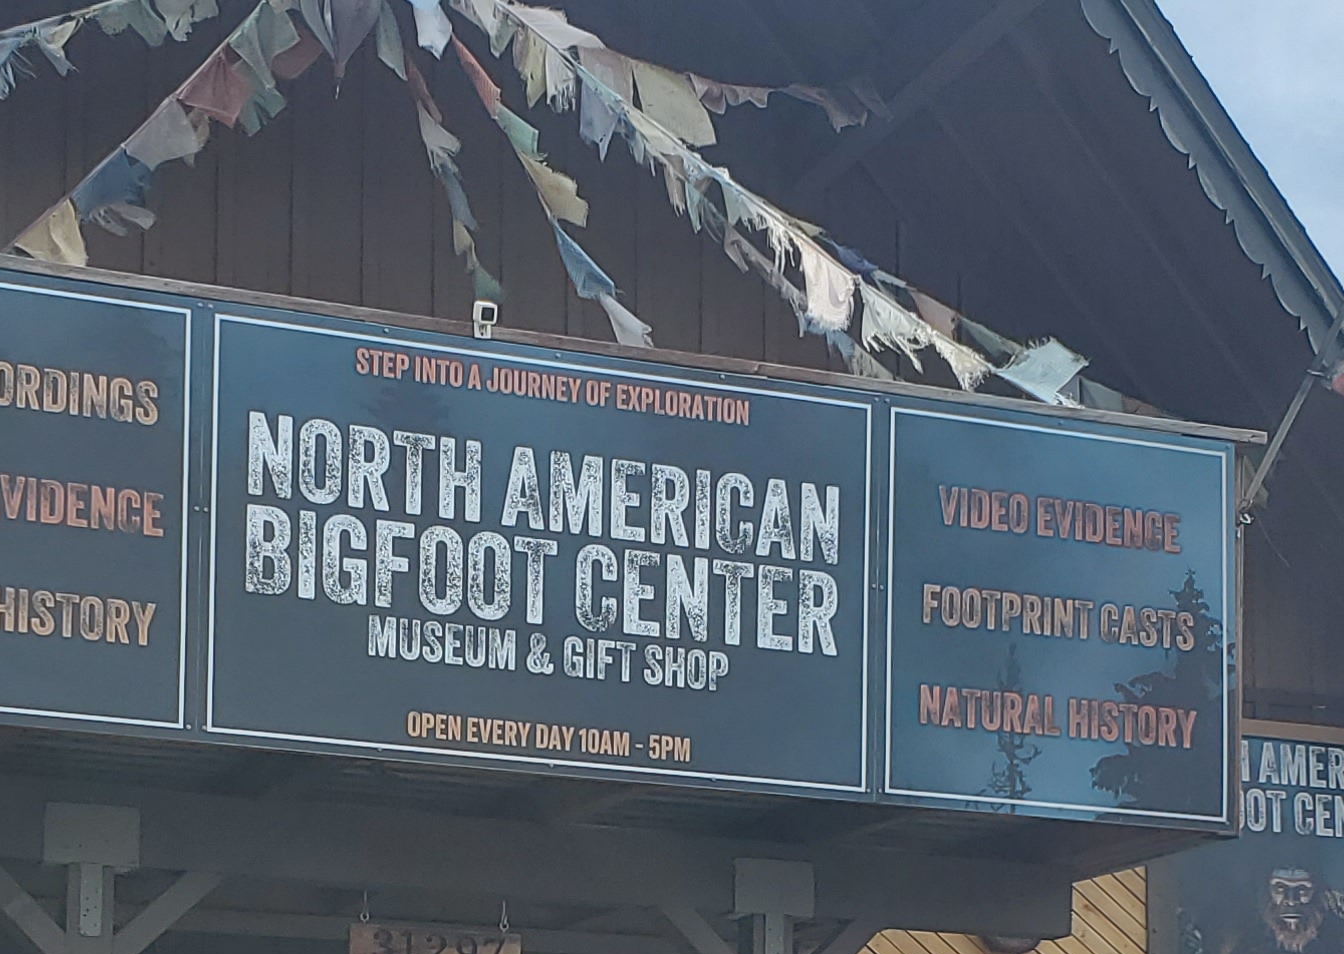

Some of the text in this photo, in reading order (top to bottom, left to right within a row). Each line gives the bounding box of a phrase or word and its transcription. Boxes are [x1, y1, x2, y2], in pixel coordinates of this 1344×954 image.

[356, 348, 750, 426] STEP INTO A JOURNEY OF EXPLORATION
[247, 411, 840, 565] NORTH AMERICAN
[938, 485, 1181, 554] VIDEO EVIDENCE
[245, 504, 837, 656] BIGFOOT CENTER
[367, 614, 729, 691] MUSEUM & GIFT SHOP
[922, 583, 1194, 652] FOOTPRINT CASTS
[407, 711, 461, 742] OPEN
[467, 717, 529, 750] EVERY
[535, 723, 574, 752] DAY
[579, 726, 630, 757] 10AM
[649, 734, 691, 762] 5PM
[919, 684, 1197, 749] NATURAL HISTORY
